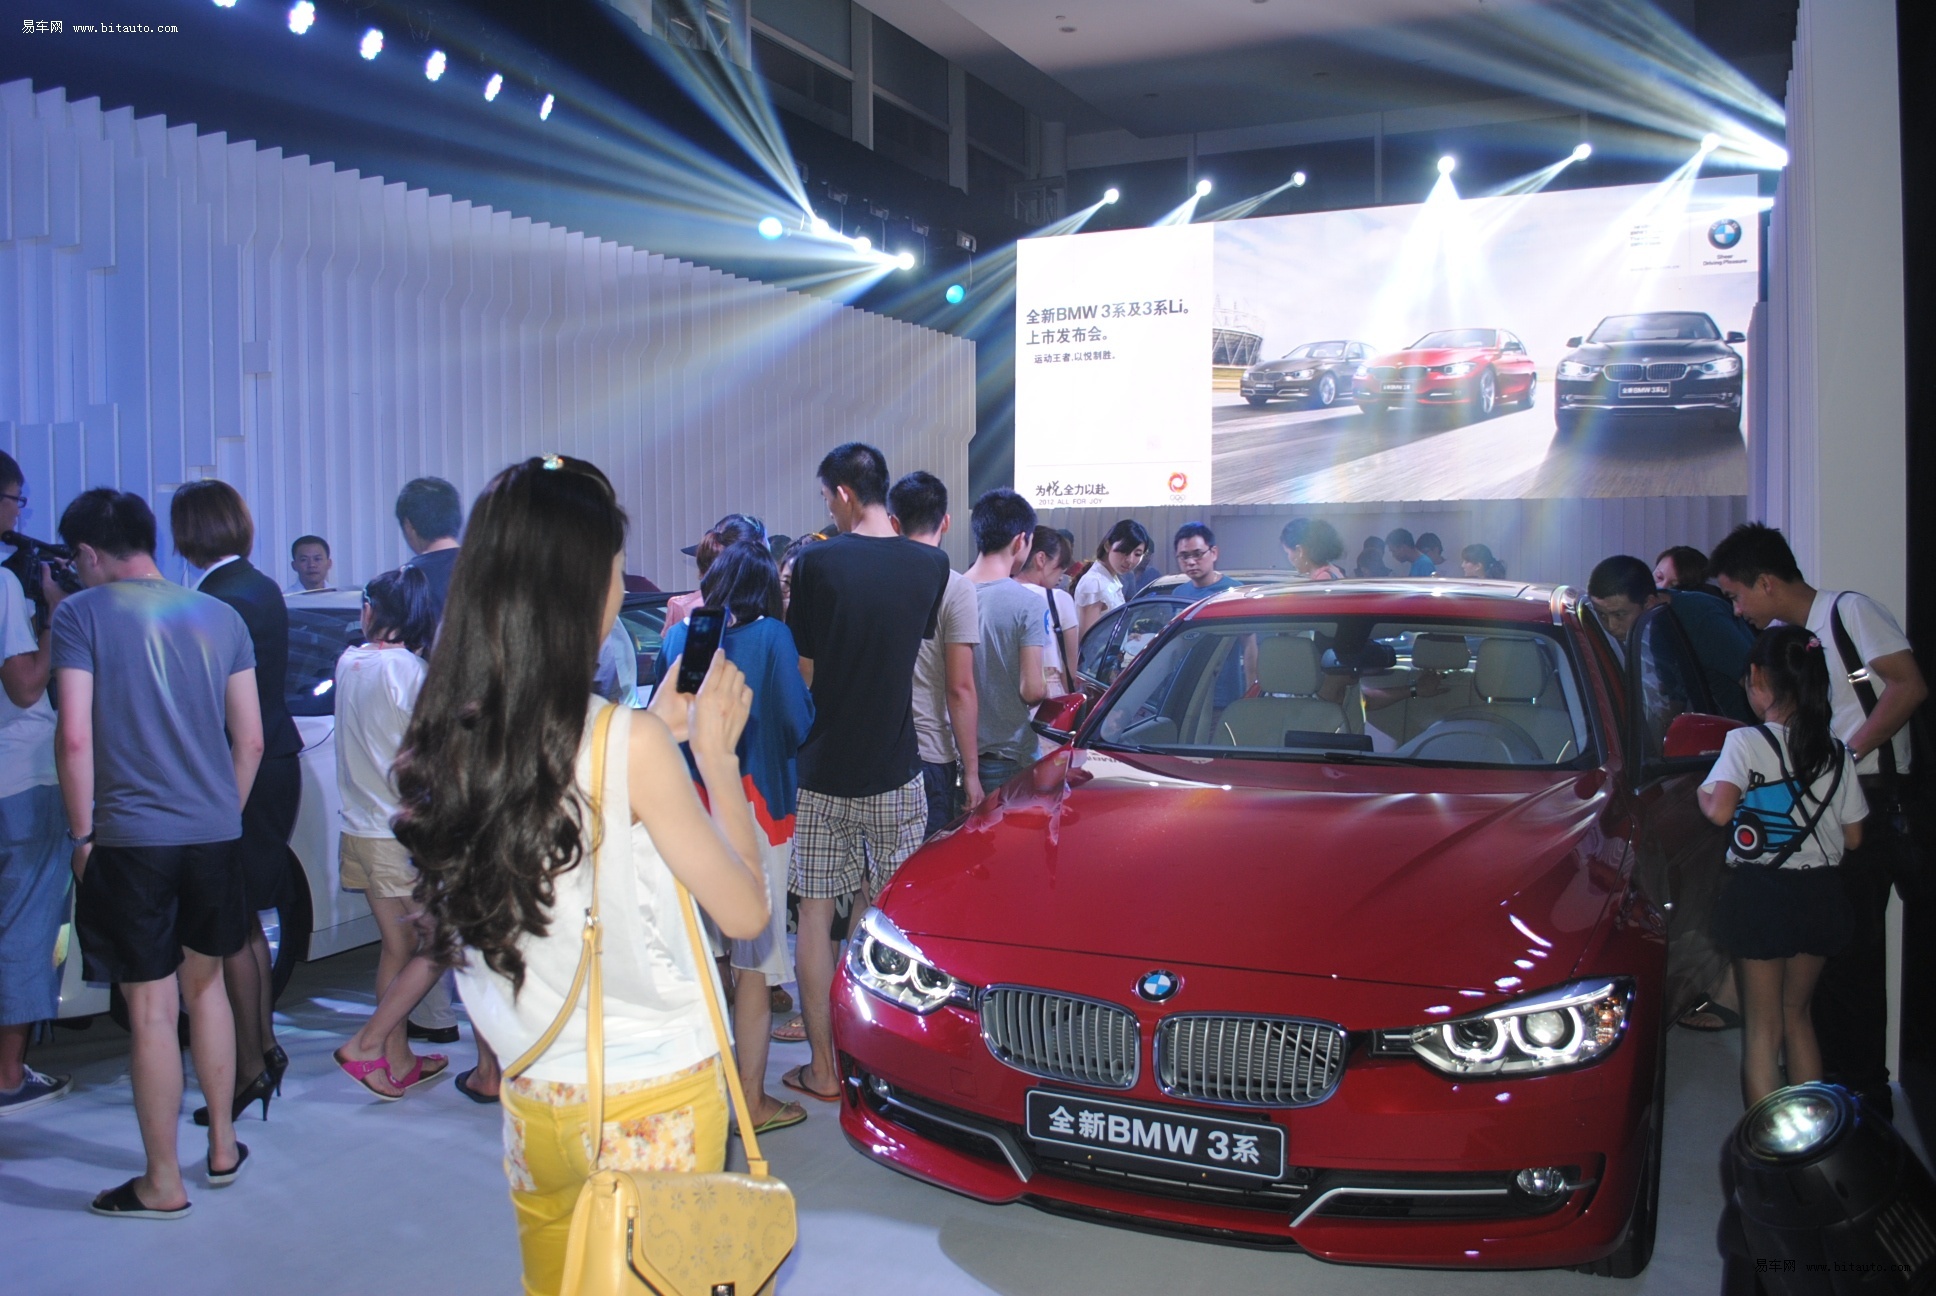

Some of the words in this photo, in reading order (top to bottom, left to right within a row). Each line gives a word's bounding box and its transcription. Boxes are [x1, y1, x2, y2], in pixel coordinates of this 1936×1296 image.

[1026, 304, 1098, 325] 全新BMW
[1026, 326, 1108, 345] 上市发布会。
[1049, 1106, 1198, 1155] 全新BMW
[1207, 1131, 1259, 1164] 3系
